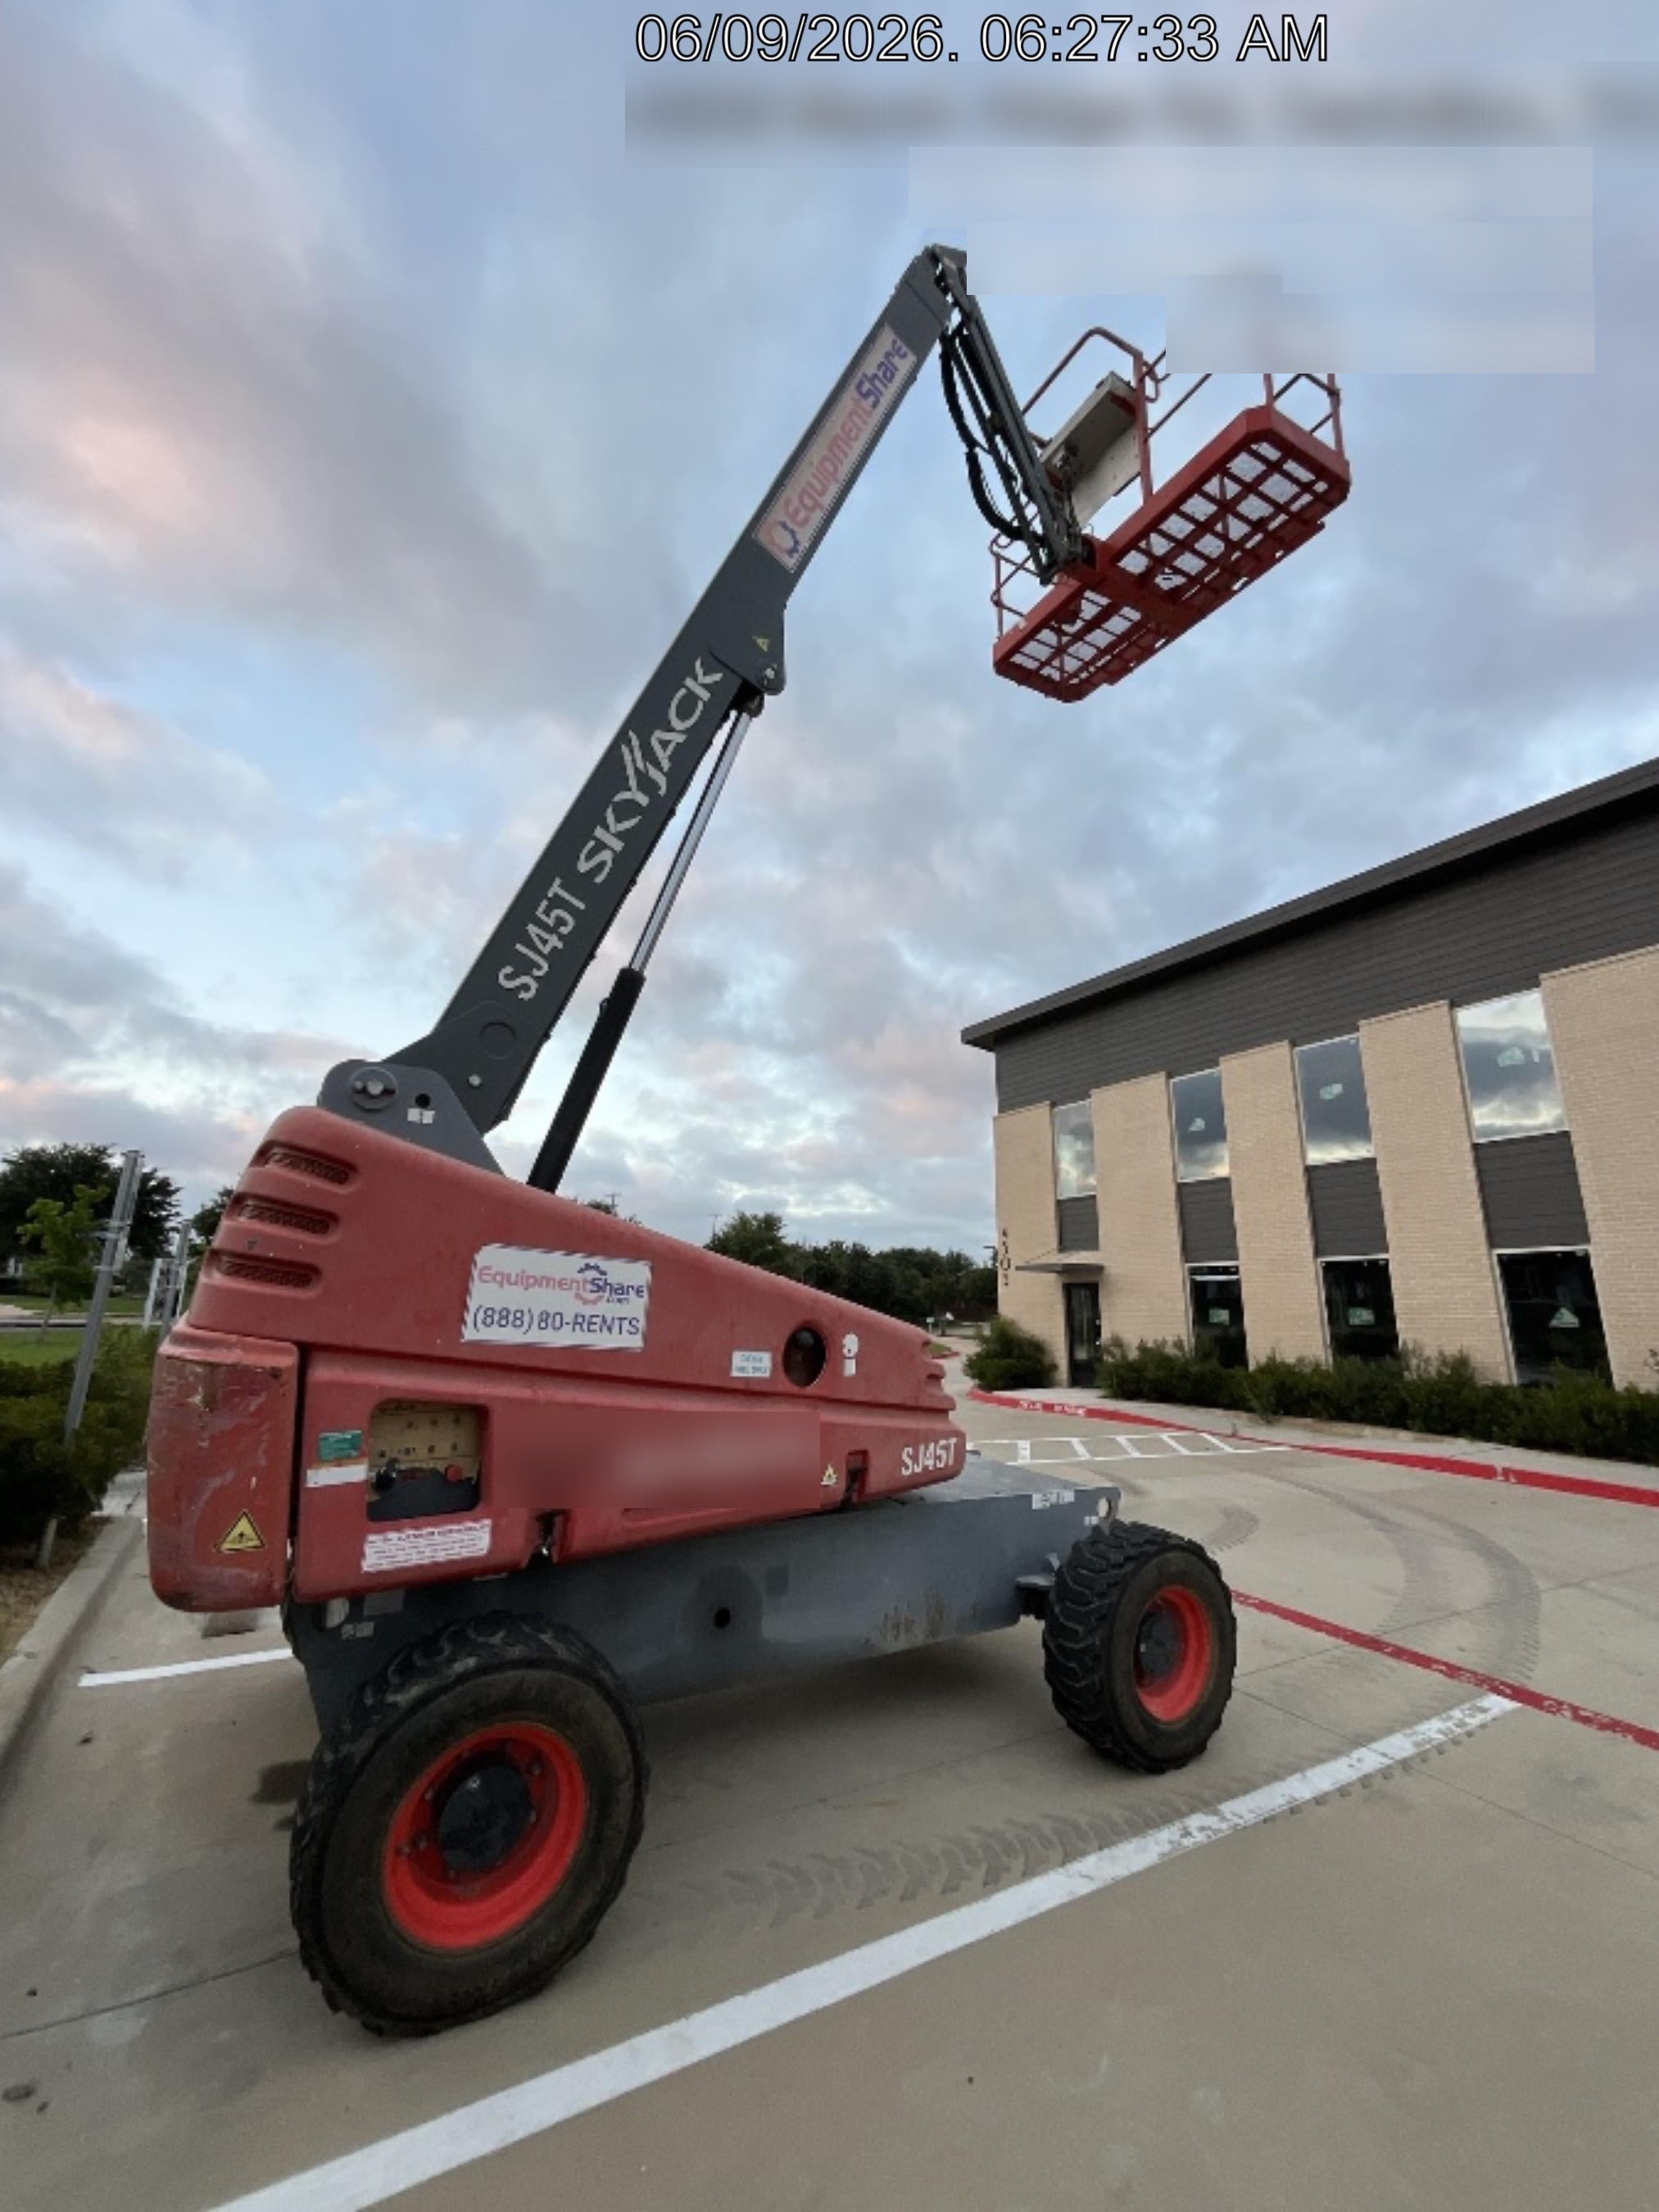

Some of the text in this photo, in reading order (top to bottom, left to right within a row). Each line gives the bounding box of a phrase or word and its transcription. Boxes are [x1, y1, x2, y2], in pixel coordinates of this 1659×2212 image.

[783, 338, 909, 528] EquipmentShare
[498, 657, 723, 1000] SJ45T SKYJACK
[901, 1437, 958, 1475] SJ45T
